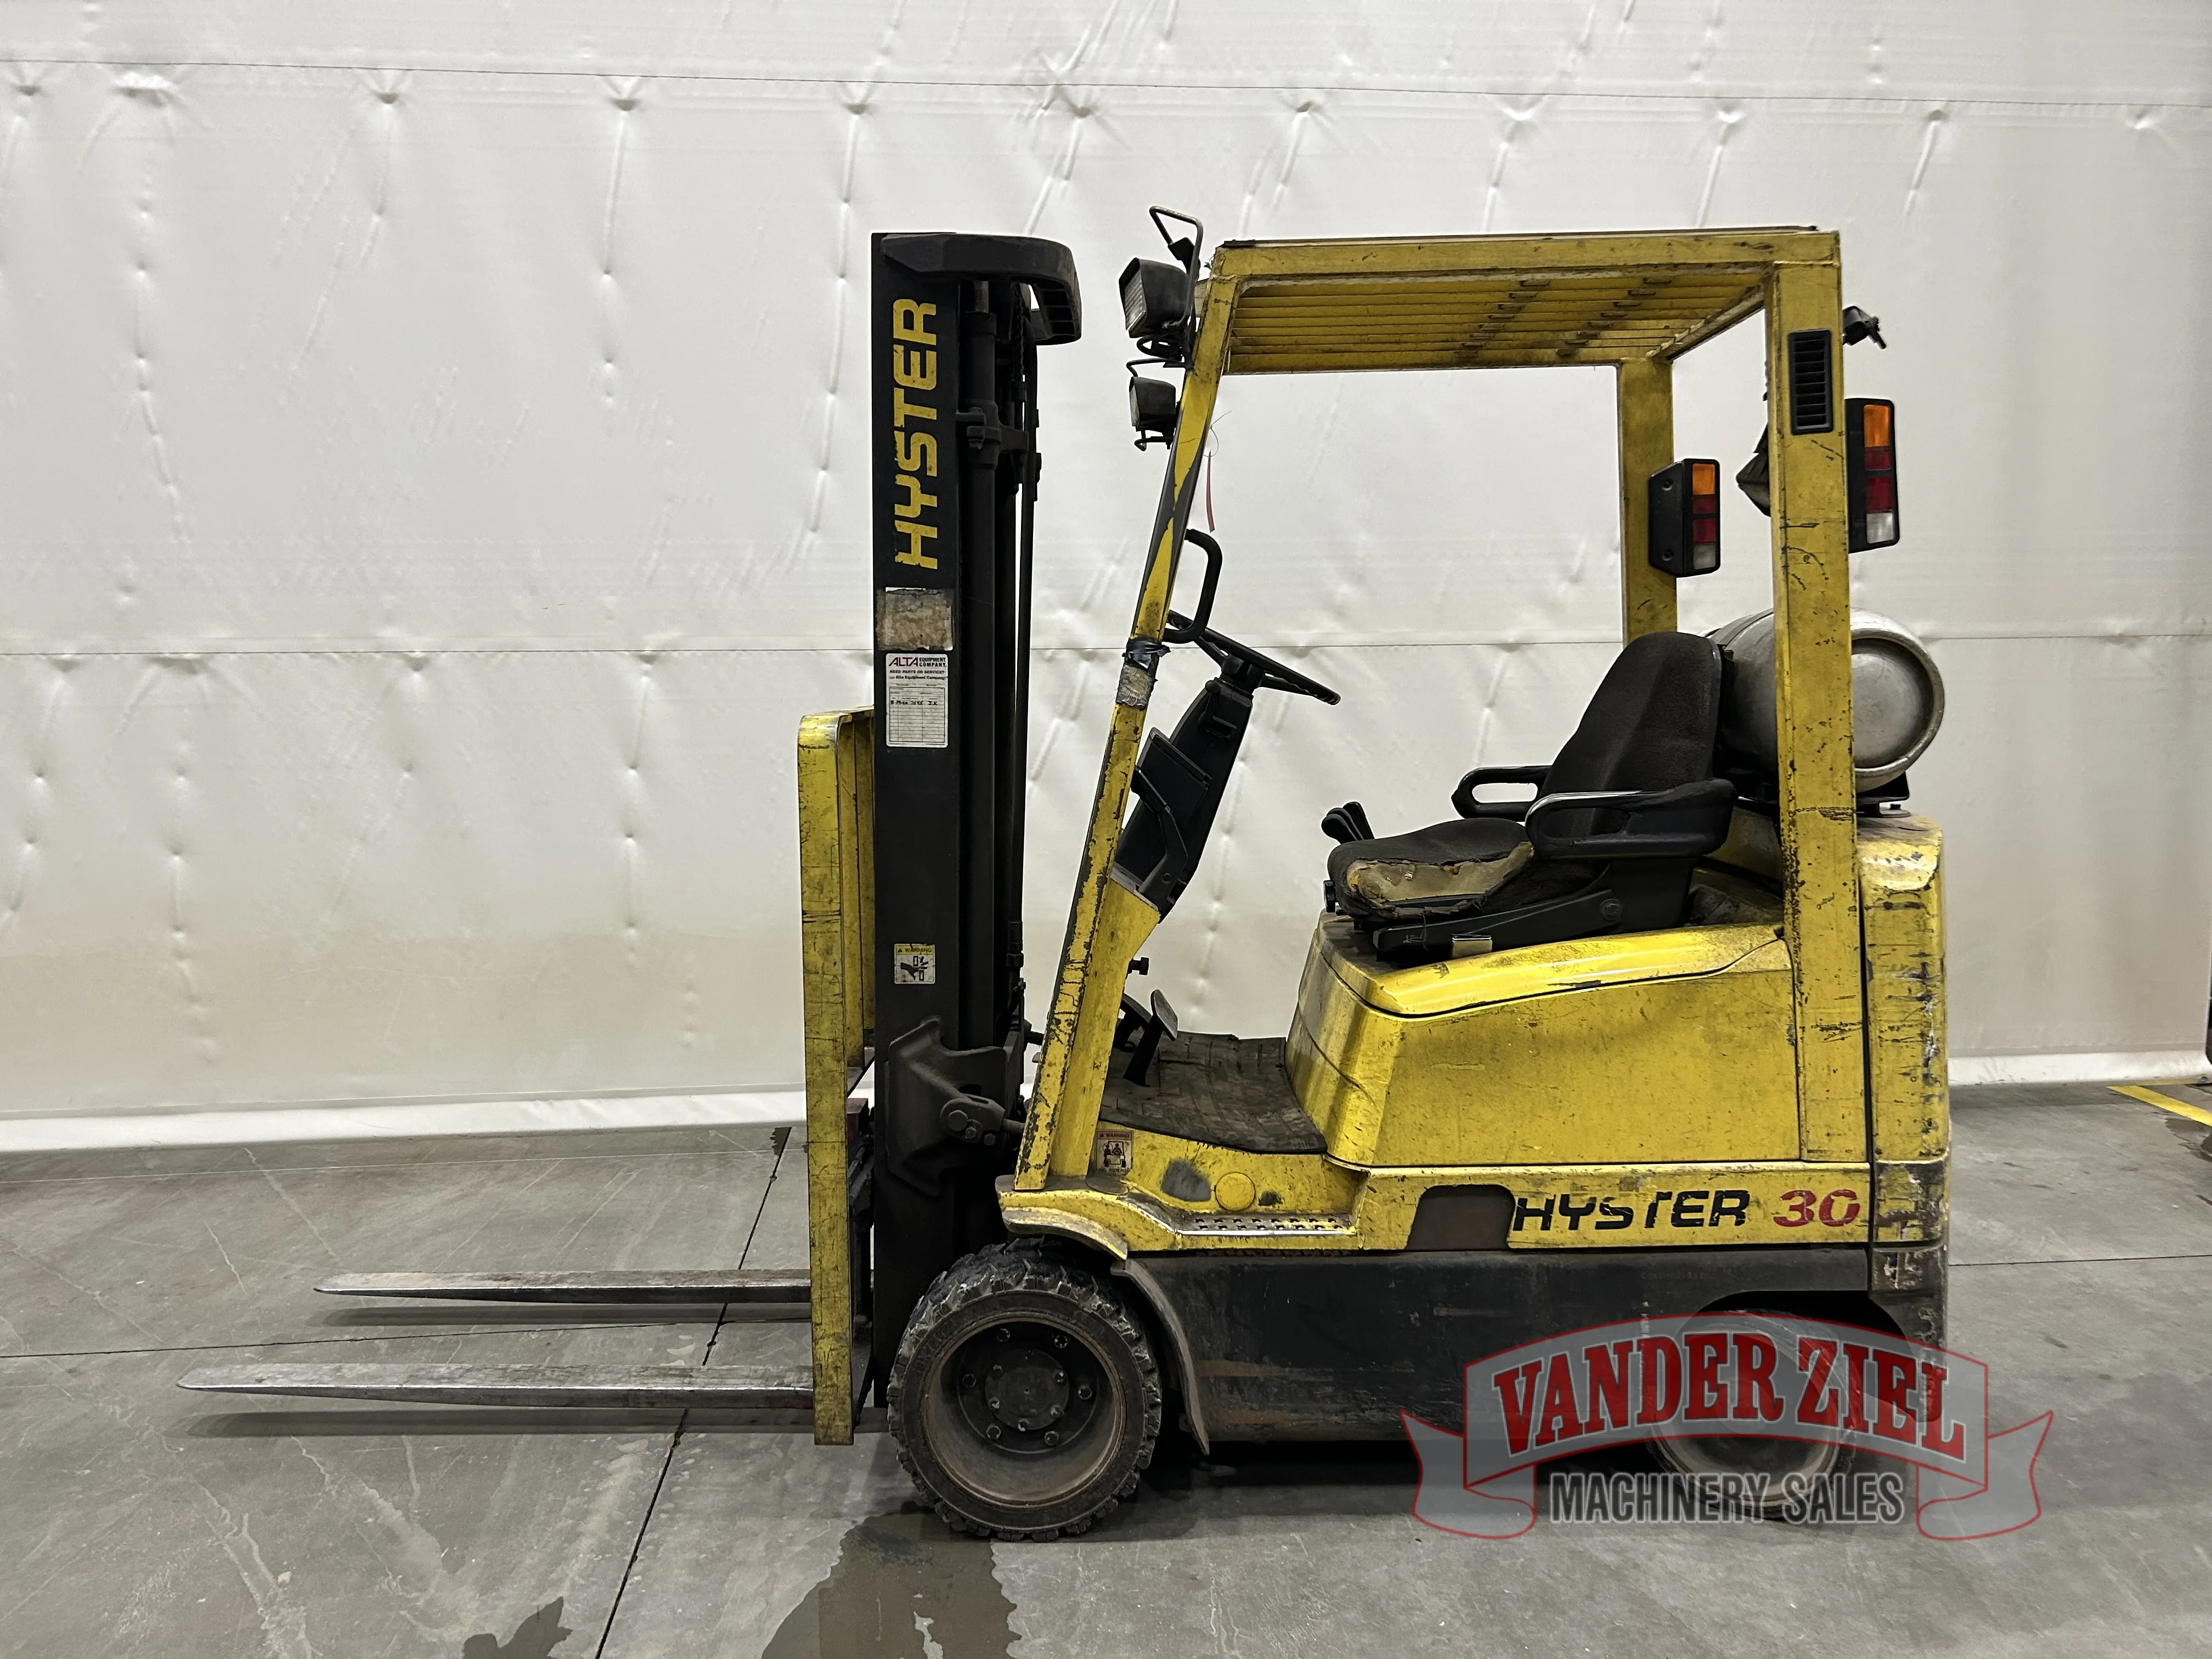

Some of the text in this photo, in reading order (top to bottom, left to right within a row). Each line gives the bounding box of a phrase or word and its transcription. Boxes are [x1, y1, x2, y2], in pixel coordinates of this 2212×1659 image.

[893, 298, 938, 570] HYSTER
[889, 657, 918, 667] ALTA
[1513, 1189, 1860, 1231] HYSTER 30
